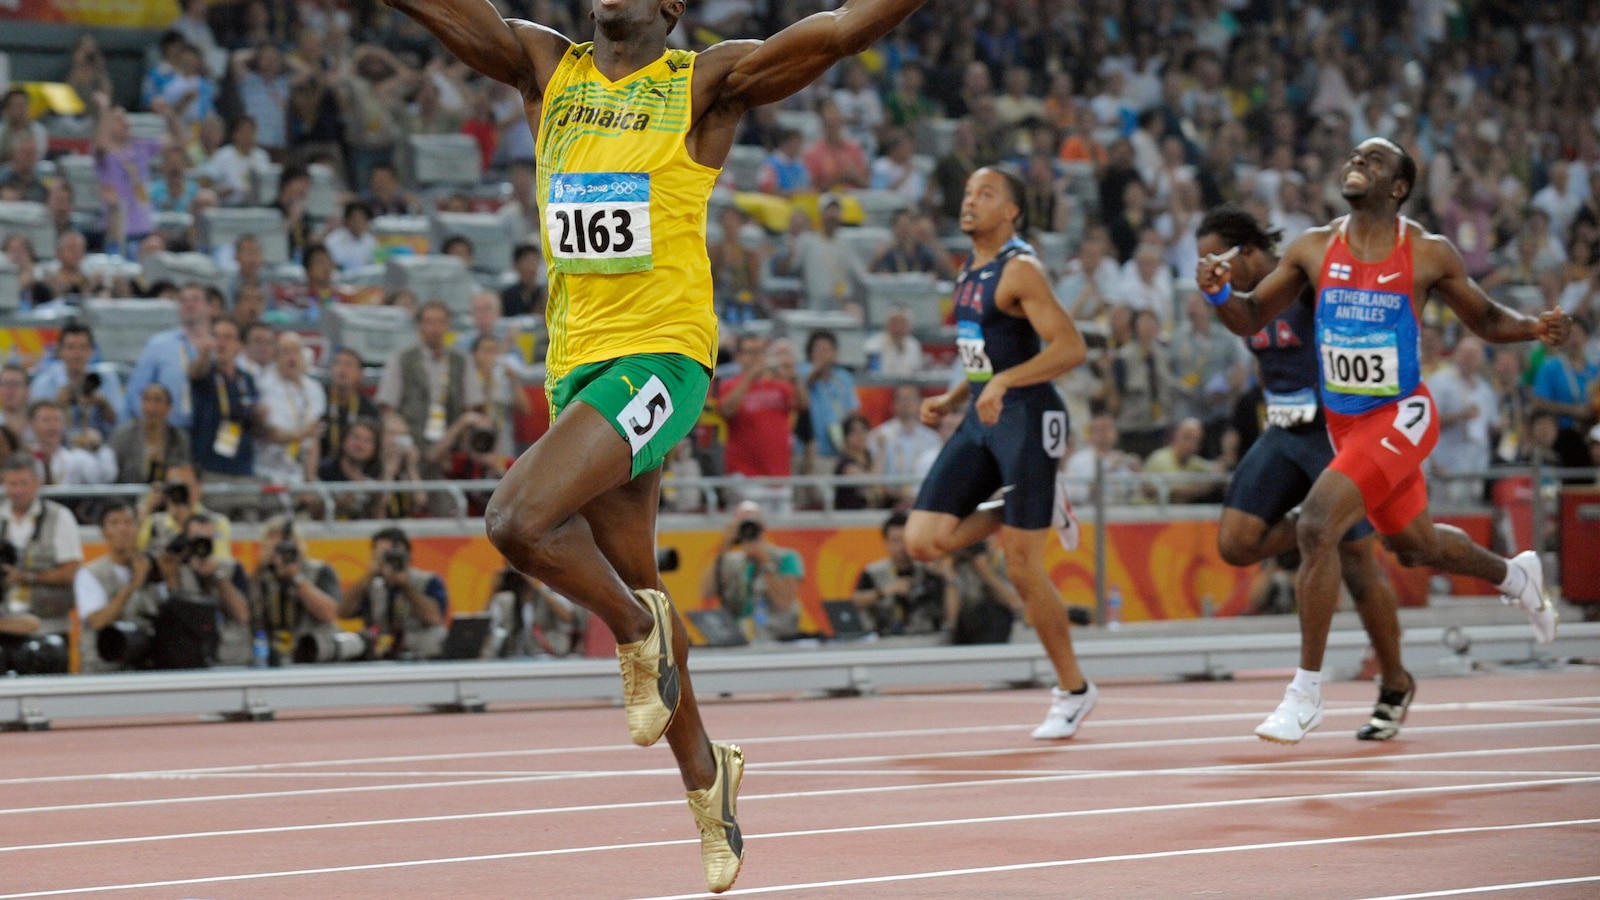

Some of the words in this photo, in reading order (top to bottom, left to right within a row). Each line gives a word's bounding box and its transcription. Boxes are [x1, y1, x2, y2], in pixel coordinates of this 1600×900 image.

[556, 209, 634, 253] 2163
[1324, 288, 1401, 310] NETHERLANDS
[1334, 305, 1386, 322] ANTILLES
[1328, 350, 1385, 383] 1003
[628, 392, 667, 436] 5
[1405, 402, 1425, 429] 7
[1049, 417, 1061, 450] 9
